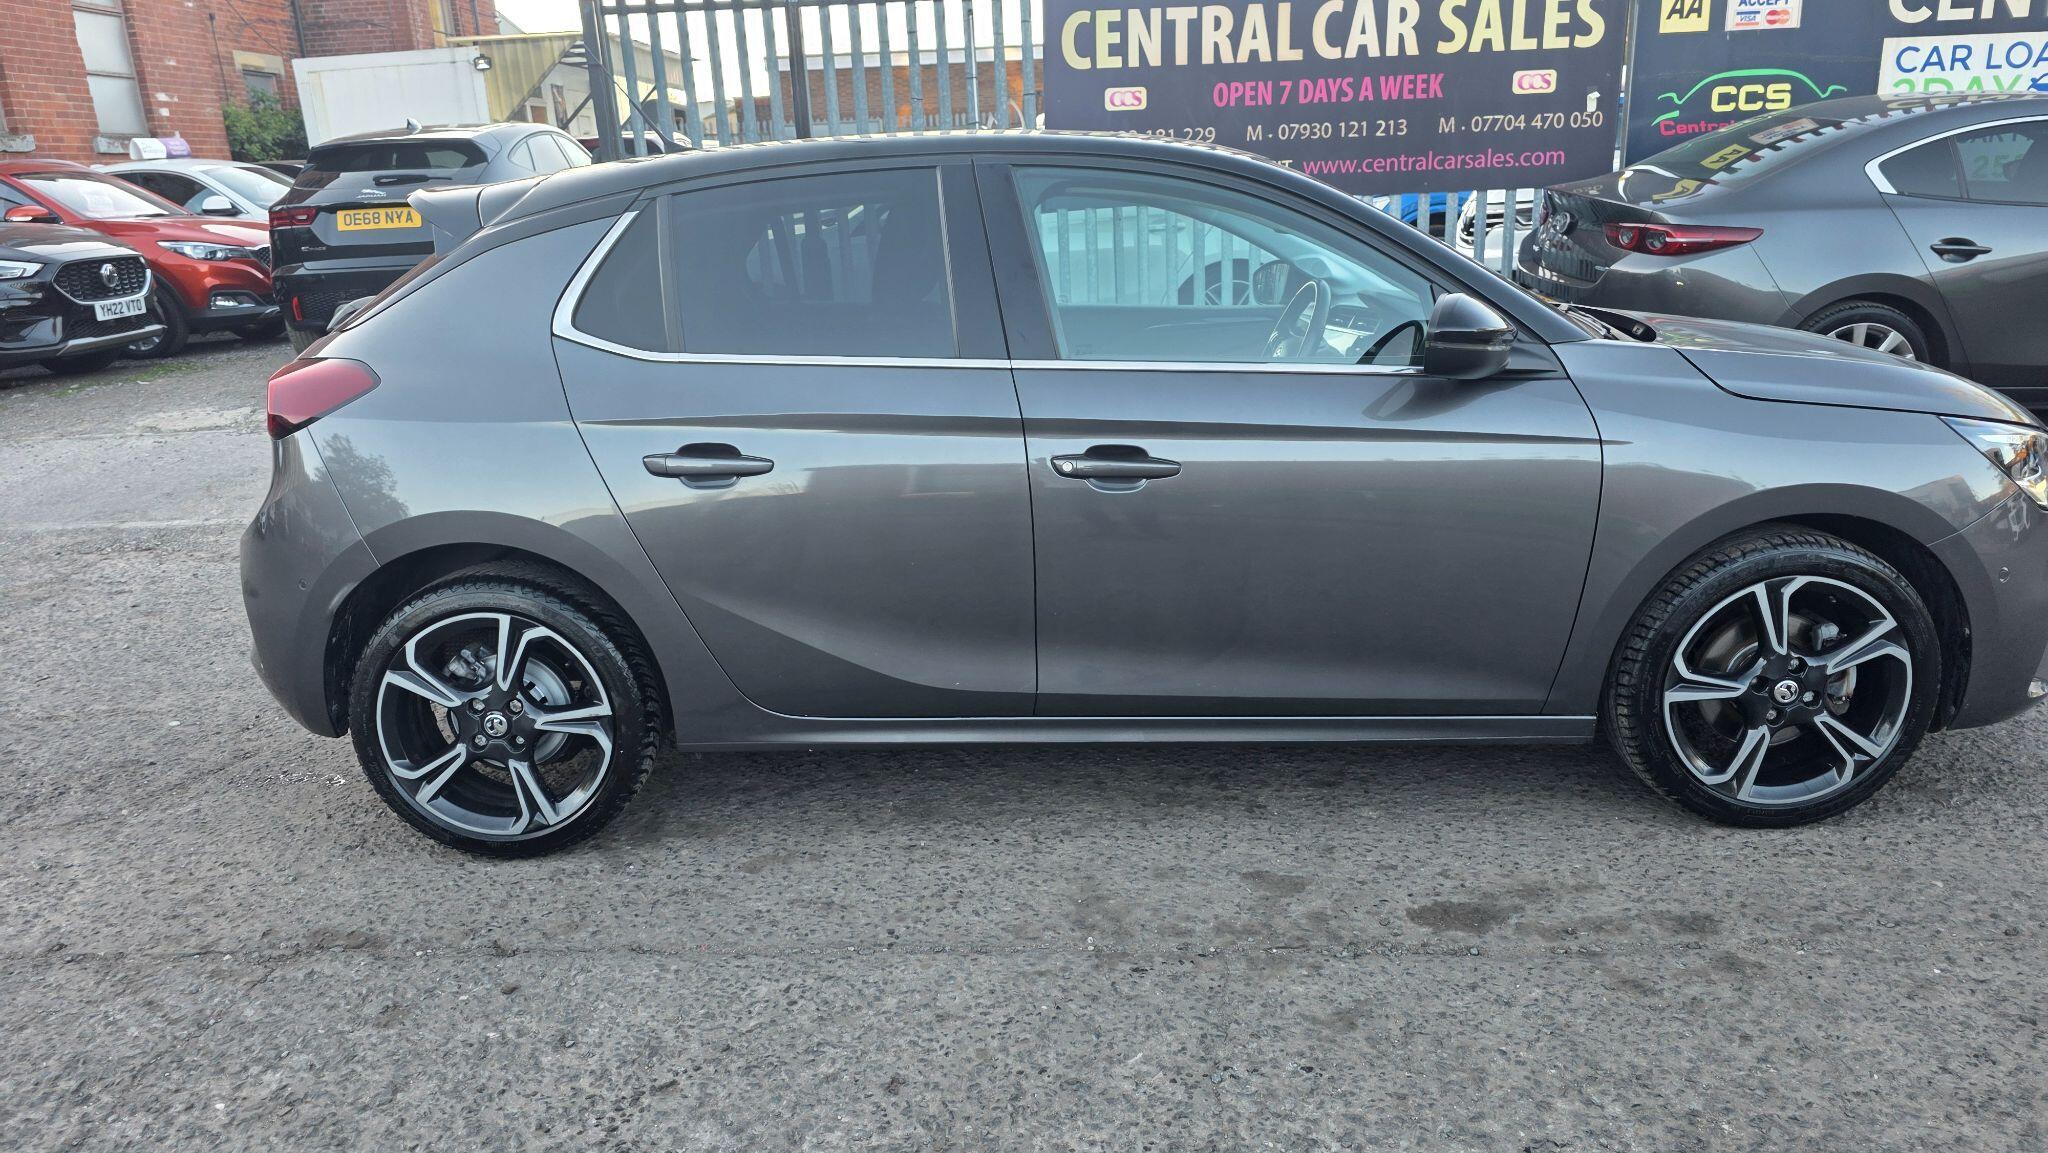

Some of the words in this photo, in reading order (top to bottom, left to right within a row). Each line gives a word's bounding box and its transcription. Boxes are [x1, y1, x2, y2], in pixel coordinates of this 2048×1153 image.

[1666, 0, 1703, 20] AA
[1061, 3, 1304, 70] CENTRAL
[1312, 0, 1420, 60] CAR
[1437, 0, 1606, 54] SALES
[1895, 44, 1973, 74] CAR
[1213, 80, 1273, 108] OPEN
[1280, 80, 1293, 105] 7
[1299, 77, 1354, 105] DAYS
[1358, 76, 1374, 101] A
[1379, 73, 1444, 100] WEEK
[1711, 83, 1792, 113] CCS
[1278, 122, 1332, 141] 07930
[1338, 121, 1367, 138] 121
[1375, 119, 1408, 137] 213
[1471, 114, 1526, 132] 07704
[1531, 112, 1565, 130] 470
[1569, 111, 1603, 128] 050
[1659, 119, 1737, 136] Centra
[1183, 126, 1216, 143] 229
[1303, 148, 1566, 176] www.centralcarsales.com
[344, 212, 381, 227] OE68
[385, 210, 414, 224] NYA
[99, 301, 125, 317] YH22
[126, 299, 143, 313] VTO
